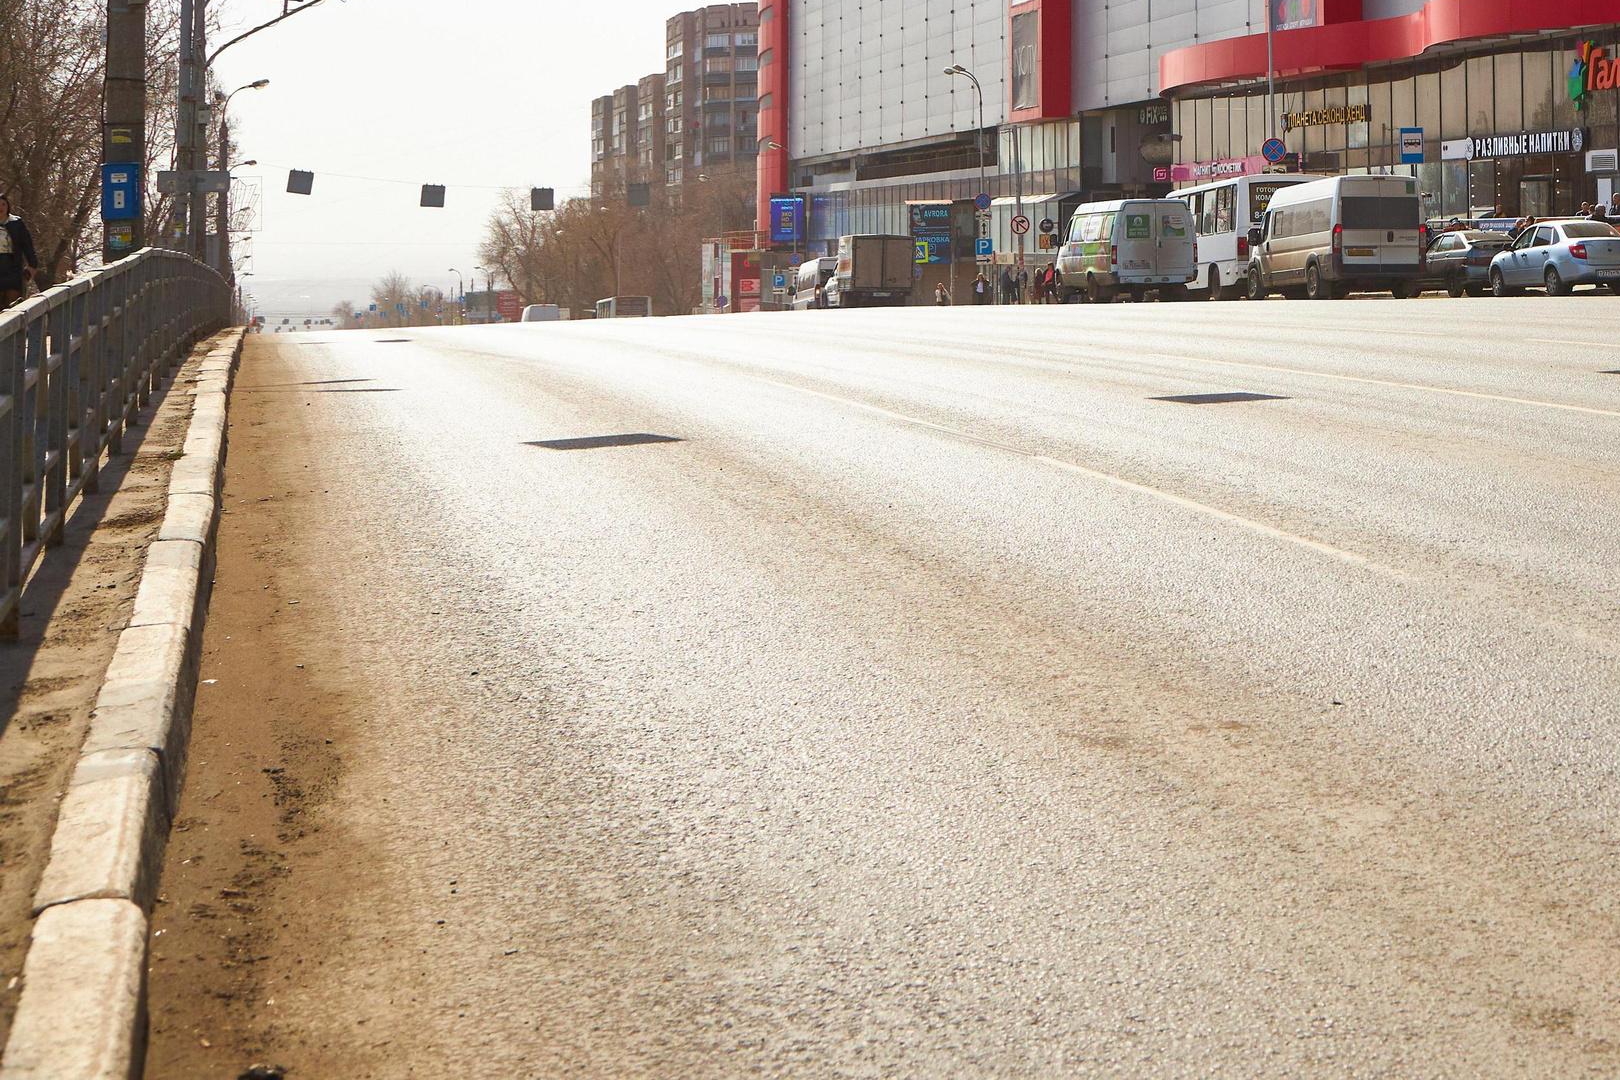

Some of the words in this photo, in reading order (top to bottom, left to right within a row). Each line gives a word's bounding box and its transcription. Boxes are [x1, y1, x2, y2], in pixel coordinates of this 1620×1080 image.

[1288, 110, 1317, 128] ПЛАНЕТА
[1475, 132, 1528, 157] РАЗЛИВНЫЕ
[1528, 130, 1570, 153] НАПИТКИ
